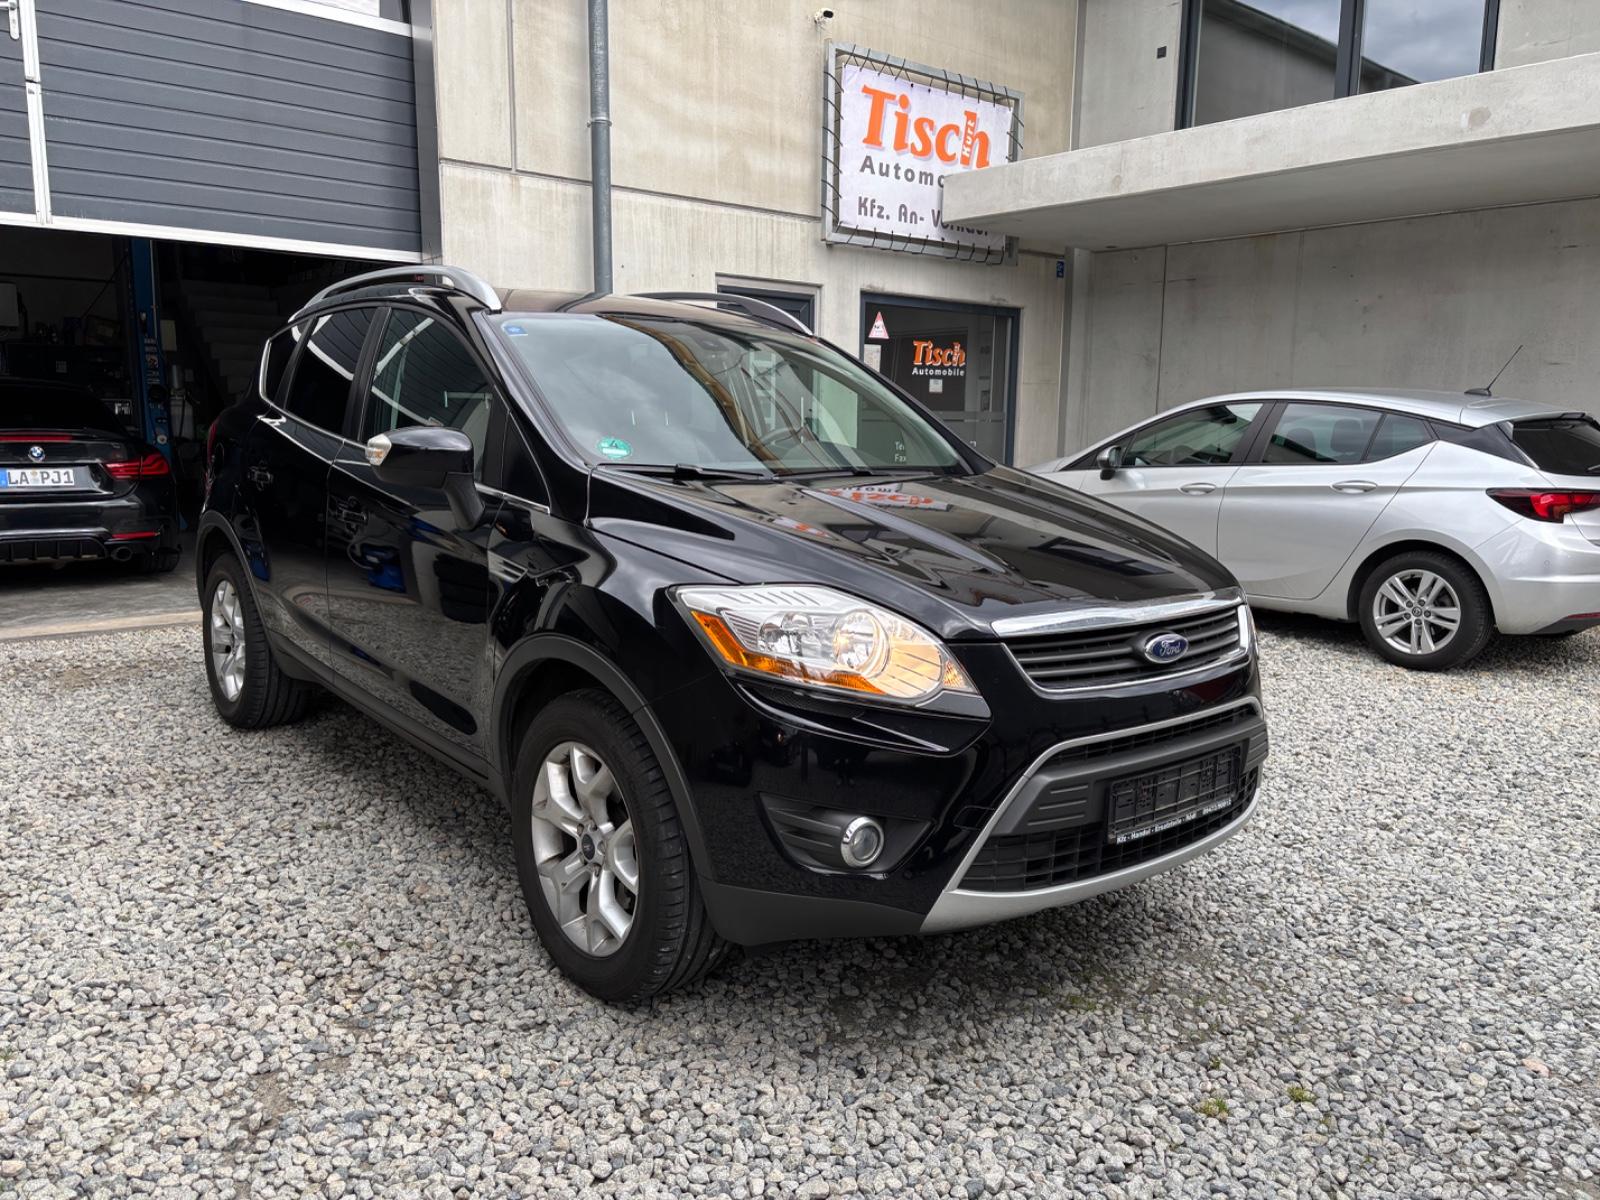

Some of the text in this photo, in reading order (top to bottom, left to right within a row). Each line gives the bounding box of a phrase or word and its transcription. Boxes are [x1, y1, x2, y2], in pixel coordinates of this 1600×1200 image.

[861, 84, 990, 169] Tisch
[857, 196, 890, 220] Kfz.
[912, 340, 966, 367] Tisch
[911, 367, 965, 377] Automobile
[8, 471, 30, 485] LA
[1160, 639, 1181, 657] Ford
